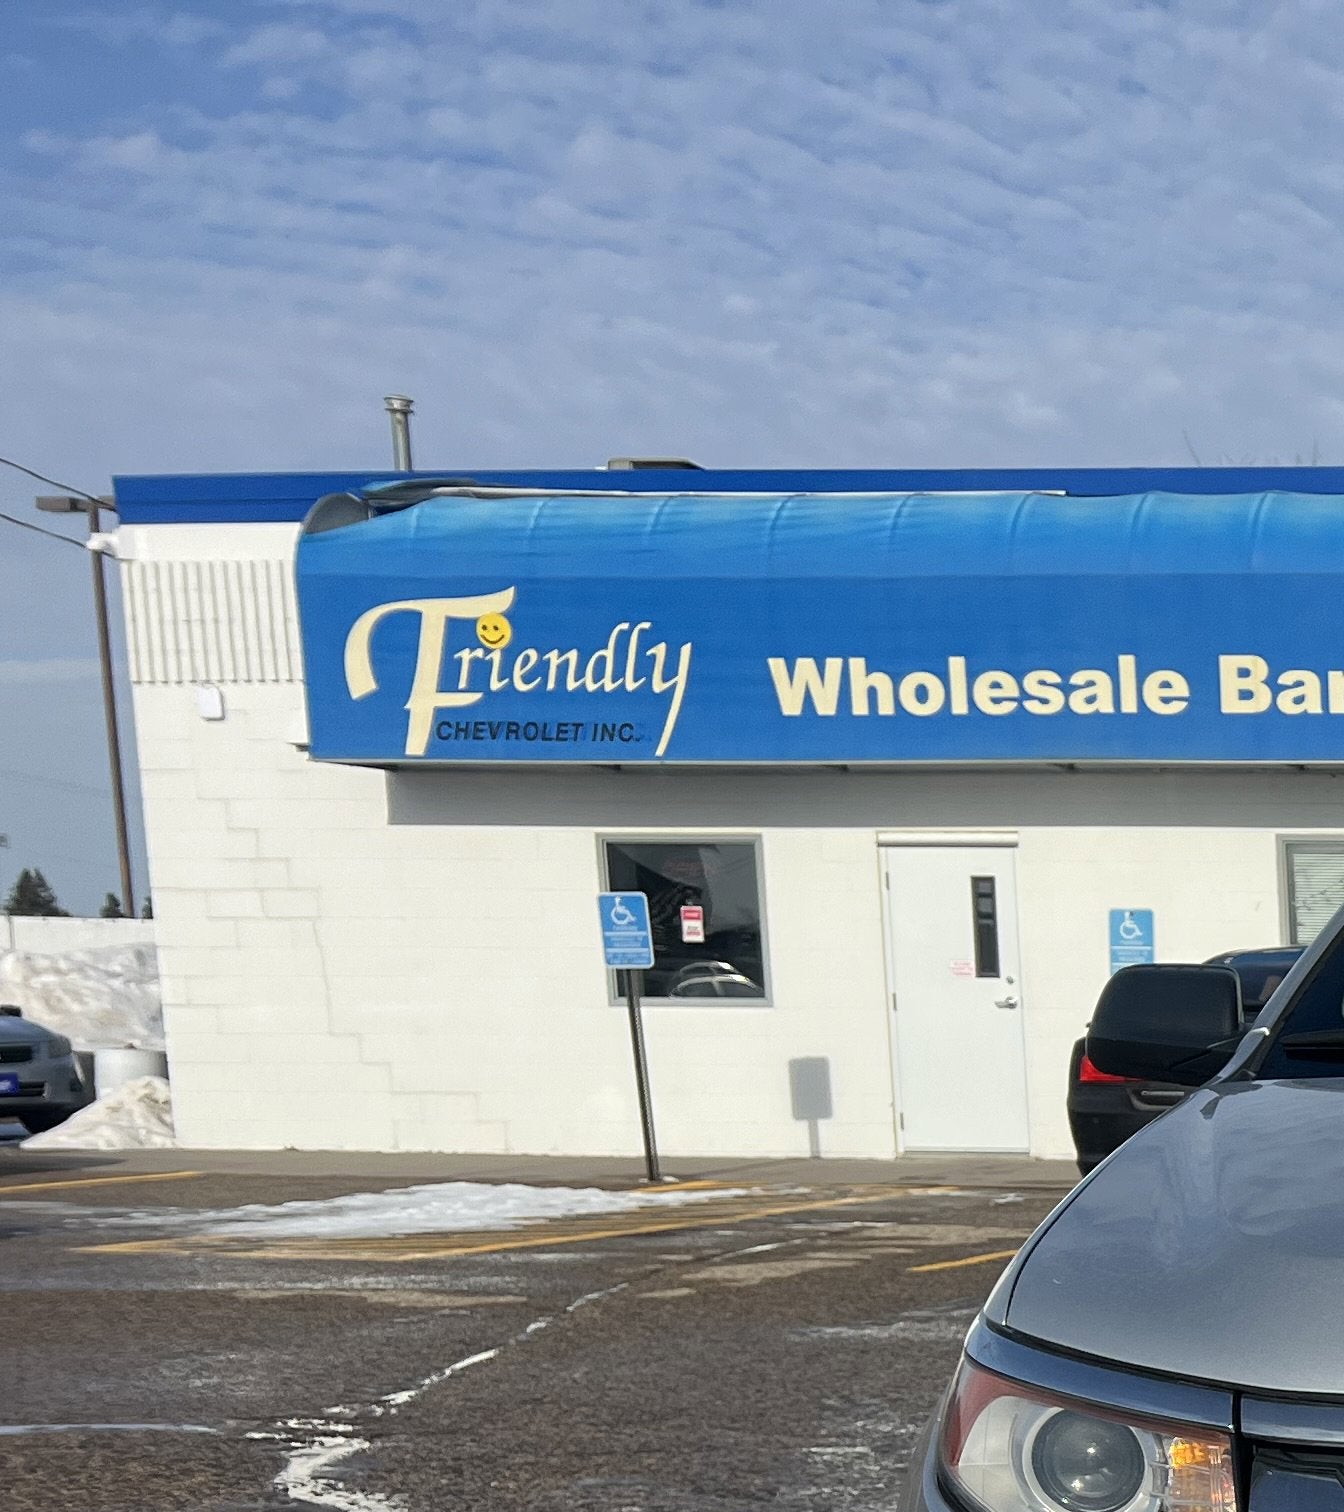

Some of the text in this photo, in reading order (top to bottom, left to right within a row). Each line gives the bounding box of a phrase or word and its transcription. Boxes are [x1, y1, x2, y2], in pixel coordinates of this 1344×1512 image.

[344, 586, 692, 756] Friendly
[767, 656, 1191, 716] Wholesale
[436, 721, 584, 742] CHEVROLET
